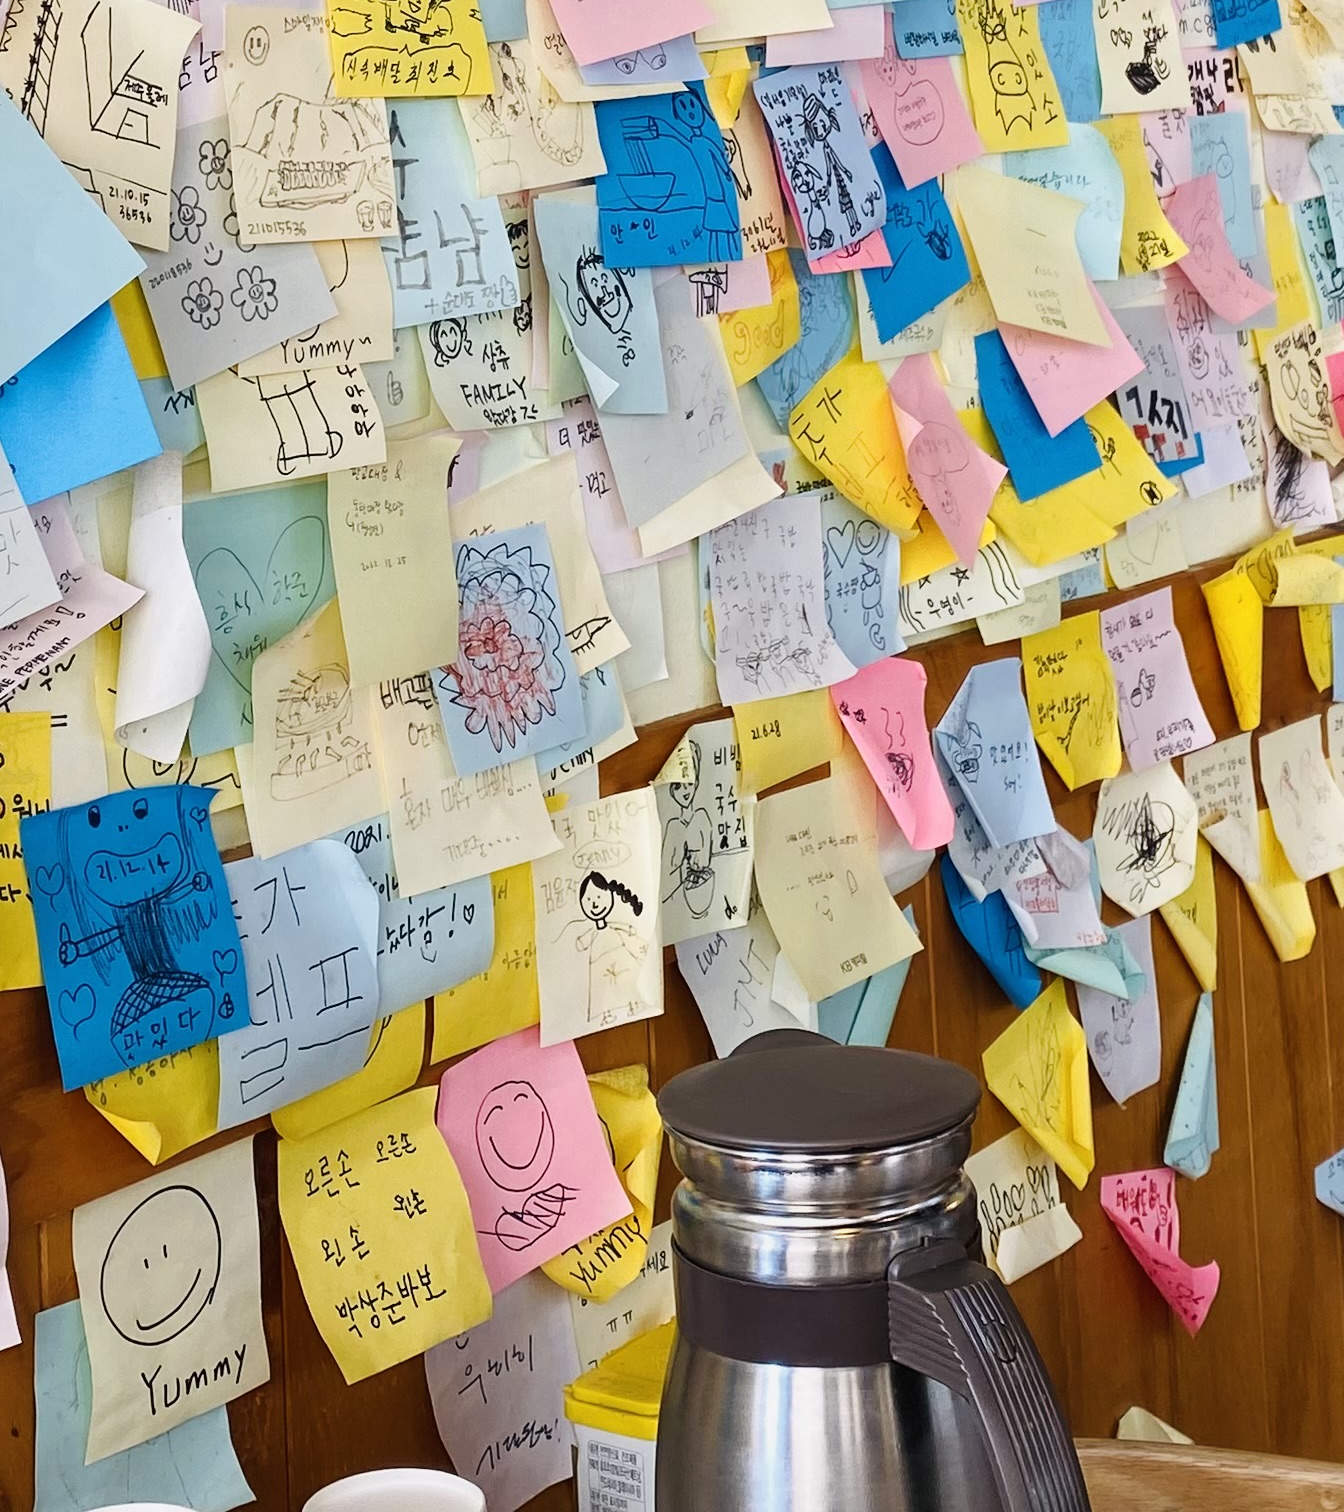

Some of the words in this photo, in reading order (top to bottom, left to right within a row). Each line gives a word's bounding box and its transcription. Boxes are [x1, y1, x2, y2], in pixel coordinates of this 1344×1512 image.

[460, 376, 526, 407] FAMILY
[304, 1149, 360, 1198] 오른손
[376, 1132, 417, 1164] 오른손
